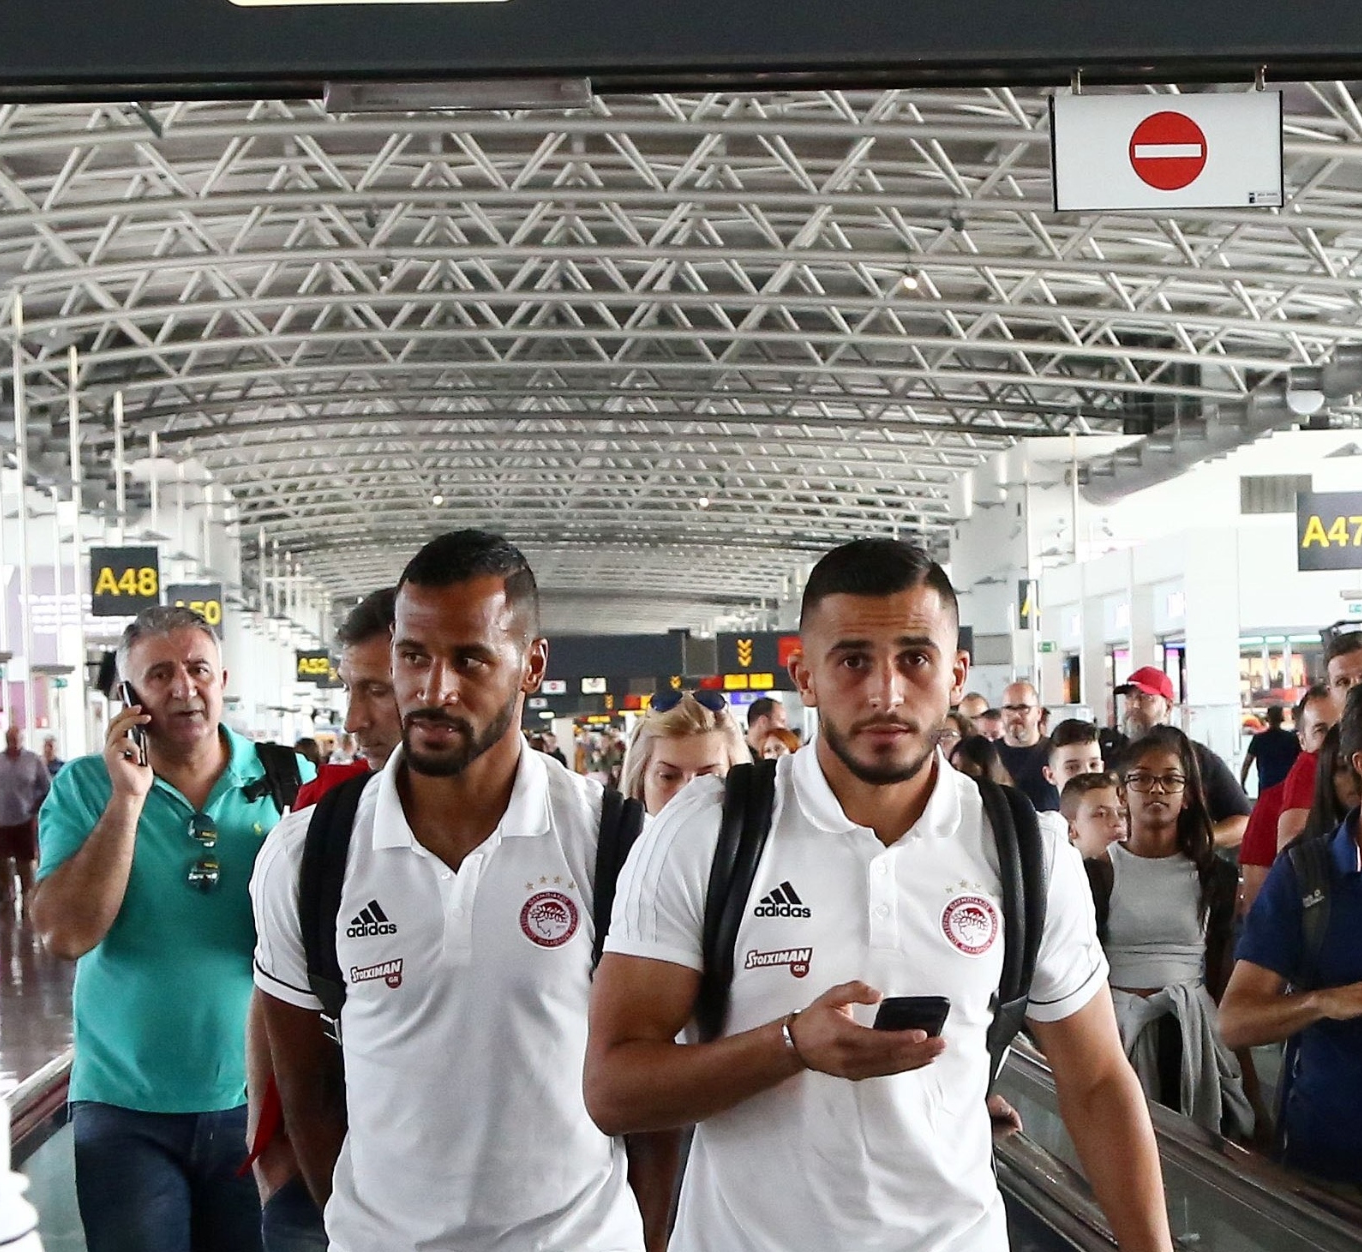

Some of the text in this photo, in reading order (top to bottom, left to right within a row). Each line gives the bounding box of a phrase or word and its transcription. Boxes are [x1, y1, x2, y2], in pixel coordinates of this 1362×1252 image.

[94, 567, 159, 596] A48
[174, 600, 223, 626] 50
[298, 657, 330, 674] A52
[753, 903, 812, 918] adidas
[346, 922, 398, 938] adidas
